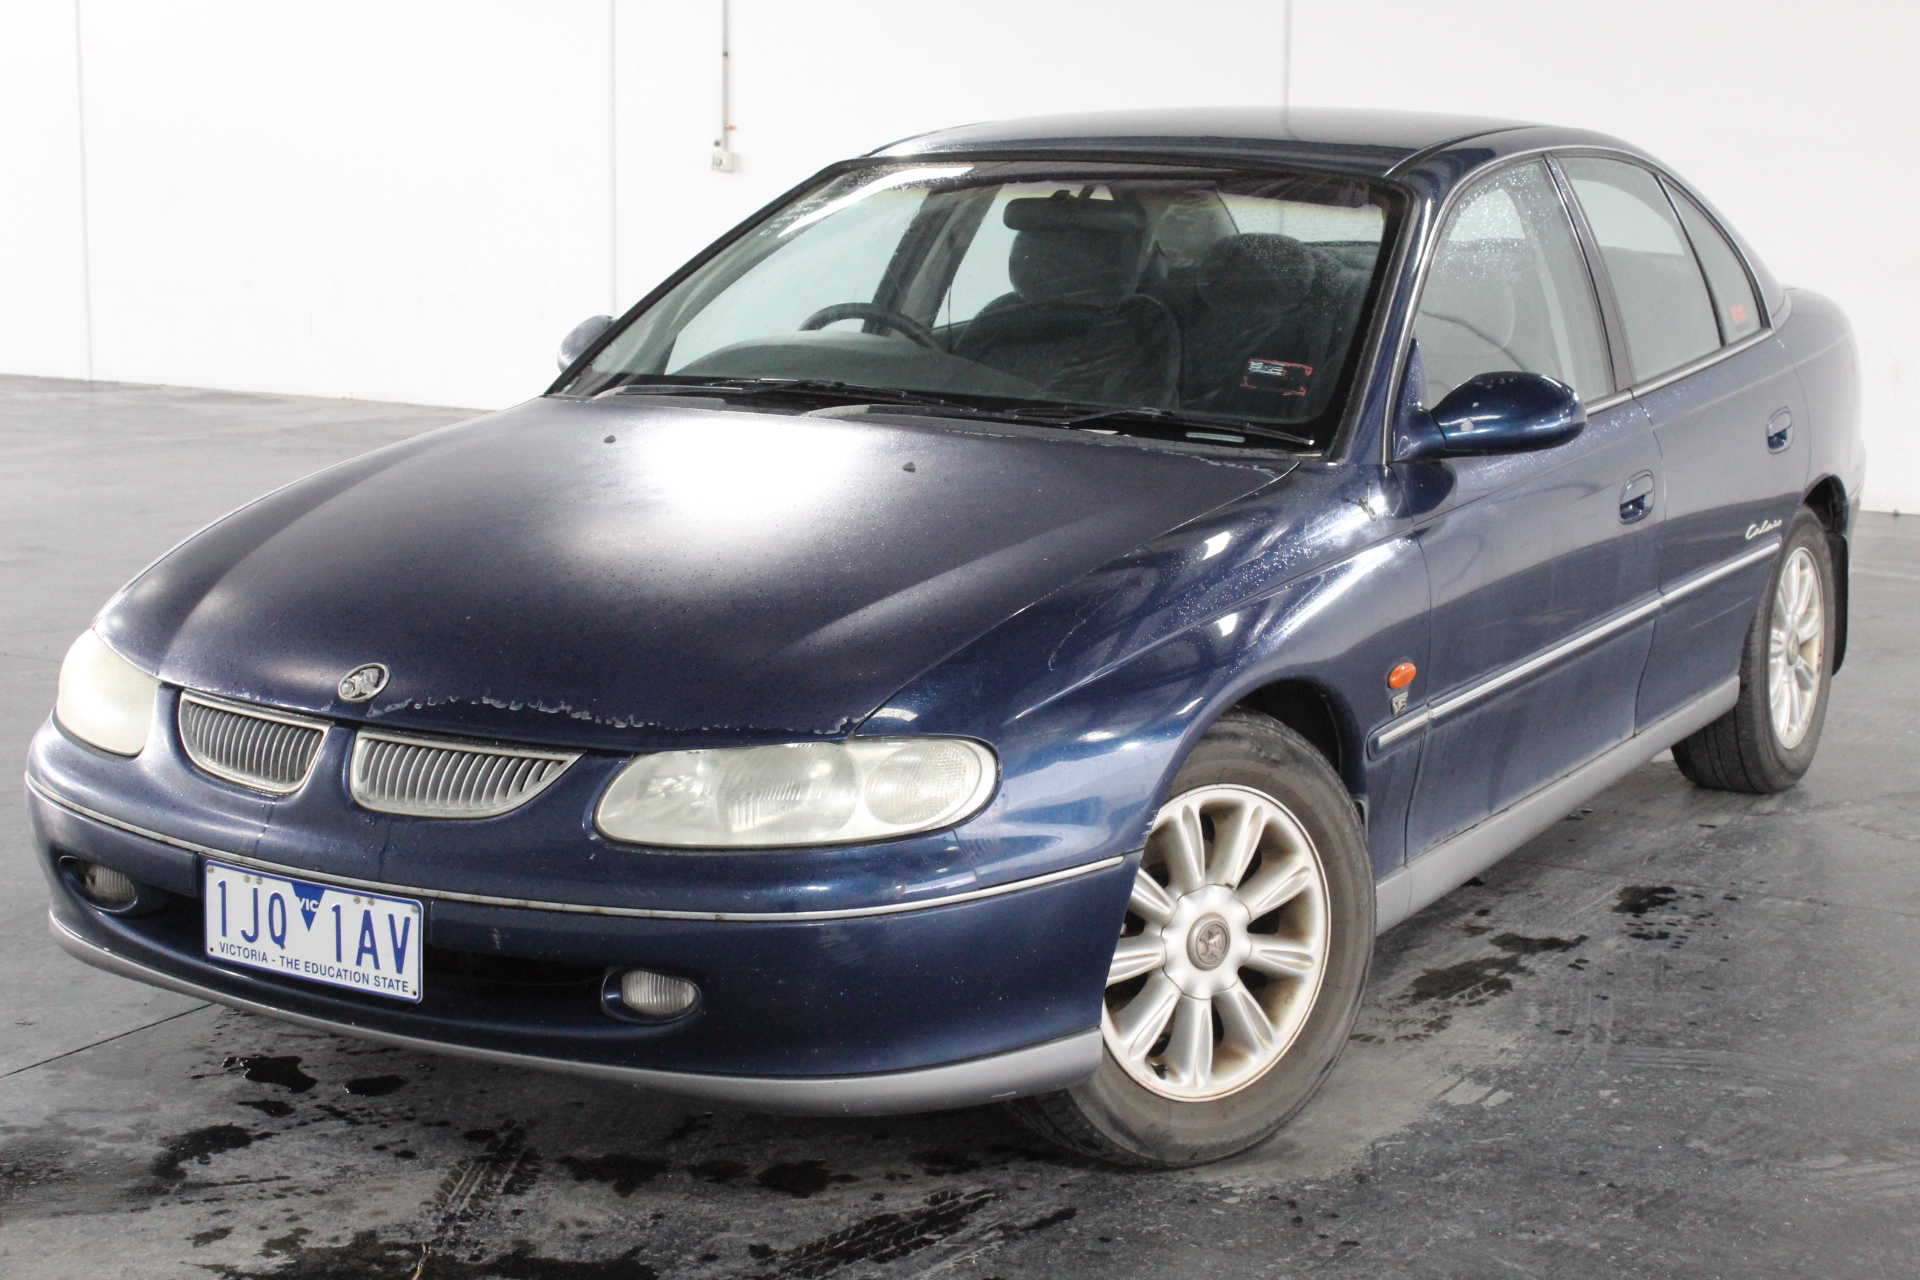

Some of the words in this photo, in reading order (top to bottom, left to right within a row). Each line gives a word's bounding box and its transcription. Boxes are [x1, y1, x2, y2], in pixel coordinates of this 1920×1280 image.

[219, 941, 268, 963] VICTORIA
[279, 956, 300, 970] THE
[304, 961, 370, 985] EDUCATION
[374, 976, 409, 993] STATE
